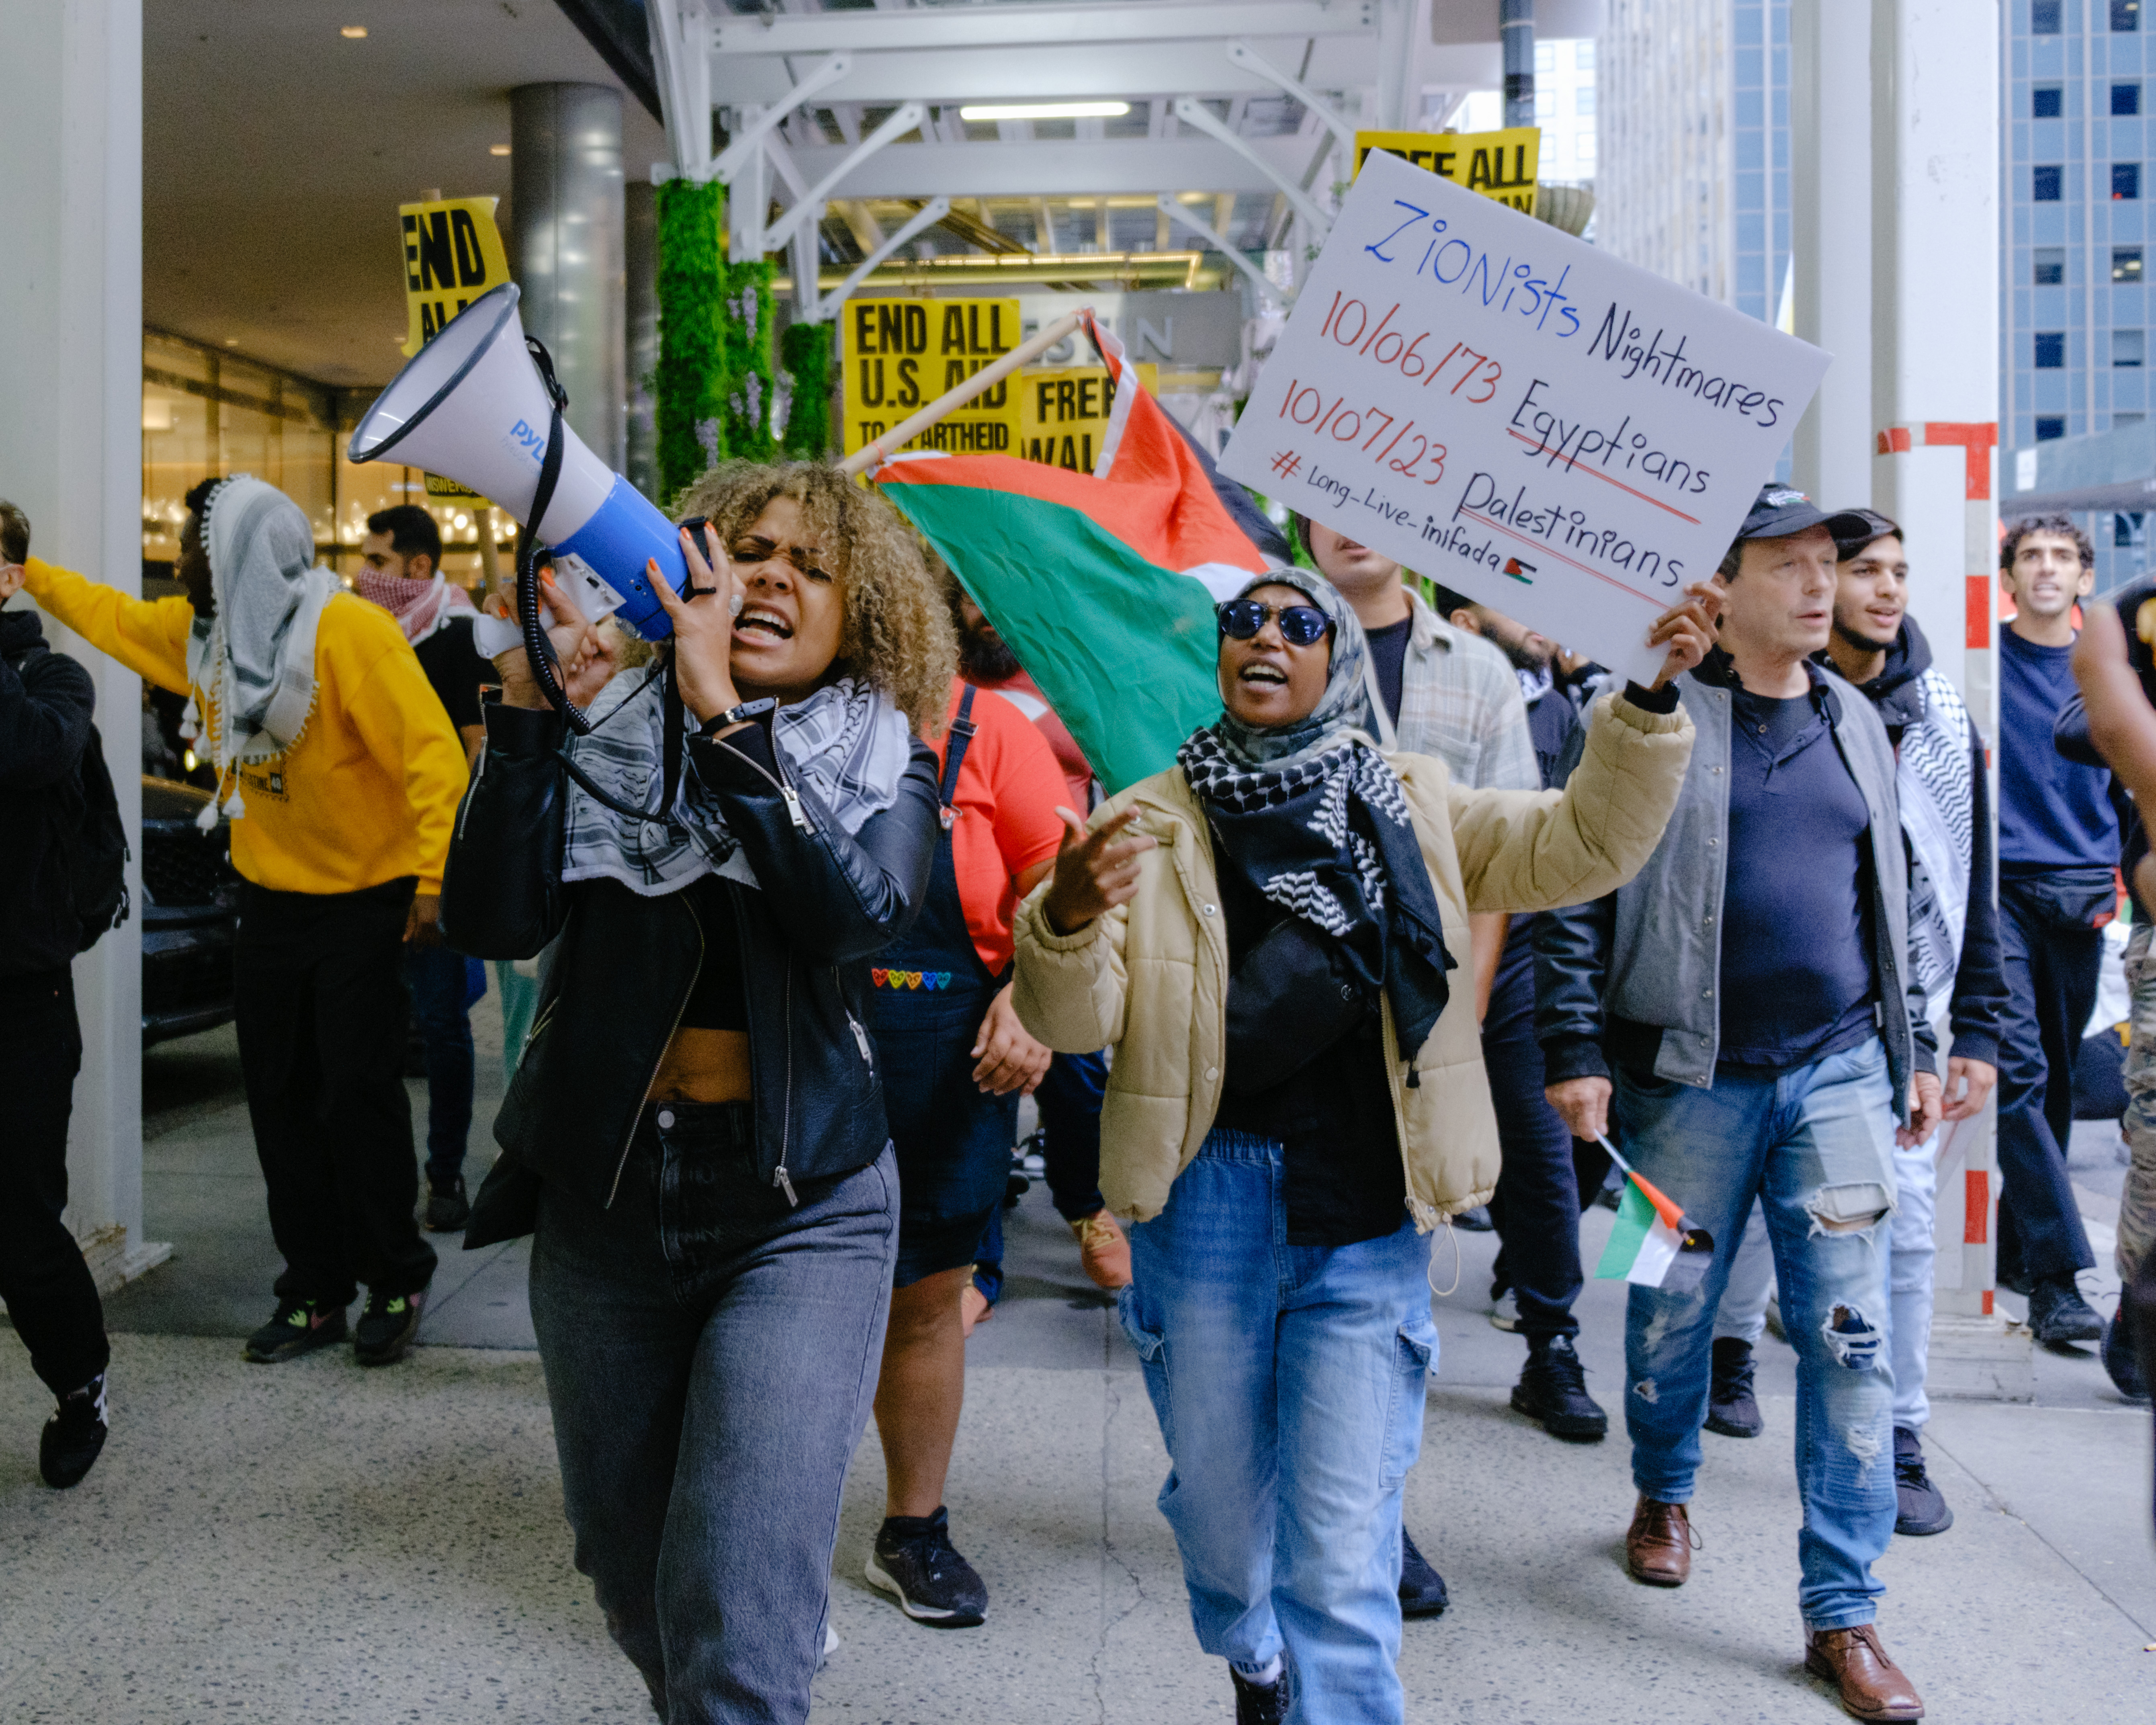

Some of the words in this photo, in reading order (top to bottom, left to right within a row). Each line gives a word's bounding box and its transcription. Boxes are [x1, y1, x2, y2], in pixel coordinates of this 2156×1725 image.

[1466, 144, 1534, 191] ALL
[402, 209, 485, 291] END
[421, 299, 468, 343] AL
[856, 305, 927, 354] END
[941, 305, 1010, 355] ALL
[860, 359, 929, 408] U.S.
[944, 359, 1007, 409] AID
[1587, 302, 1785, 428] Nightmares
[1321, 290, 1503, 404] 10/06/73
[1511, 379, 1710, 494] Egyptians
[510, 418, 545, 465] PYL
[859, 421, 885, 446] TO
[895, 420, 1009, 451] ARTHEID
[1280, 379, 1447, 485] 10/07/23
